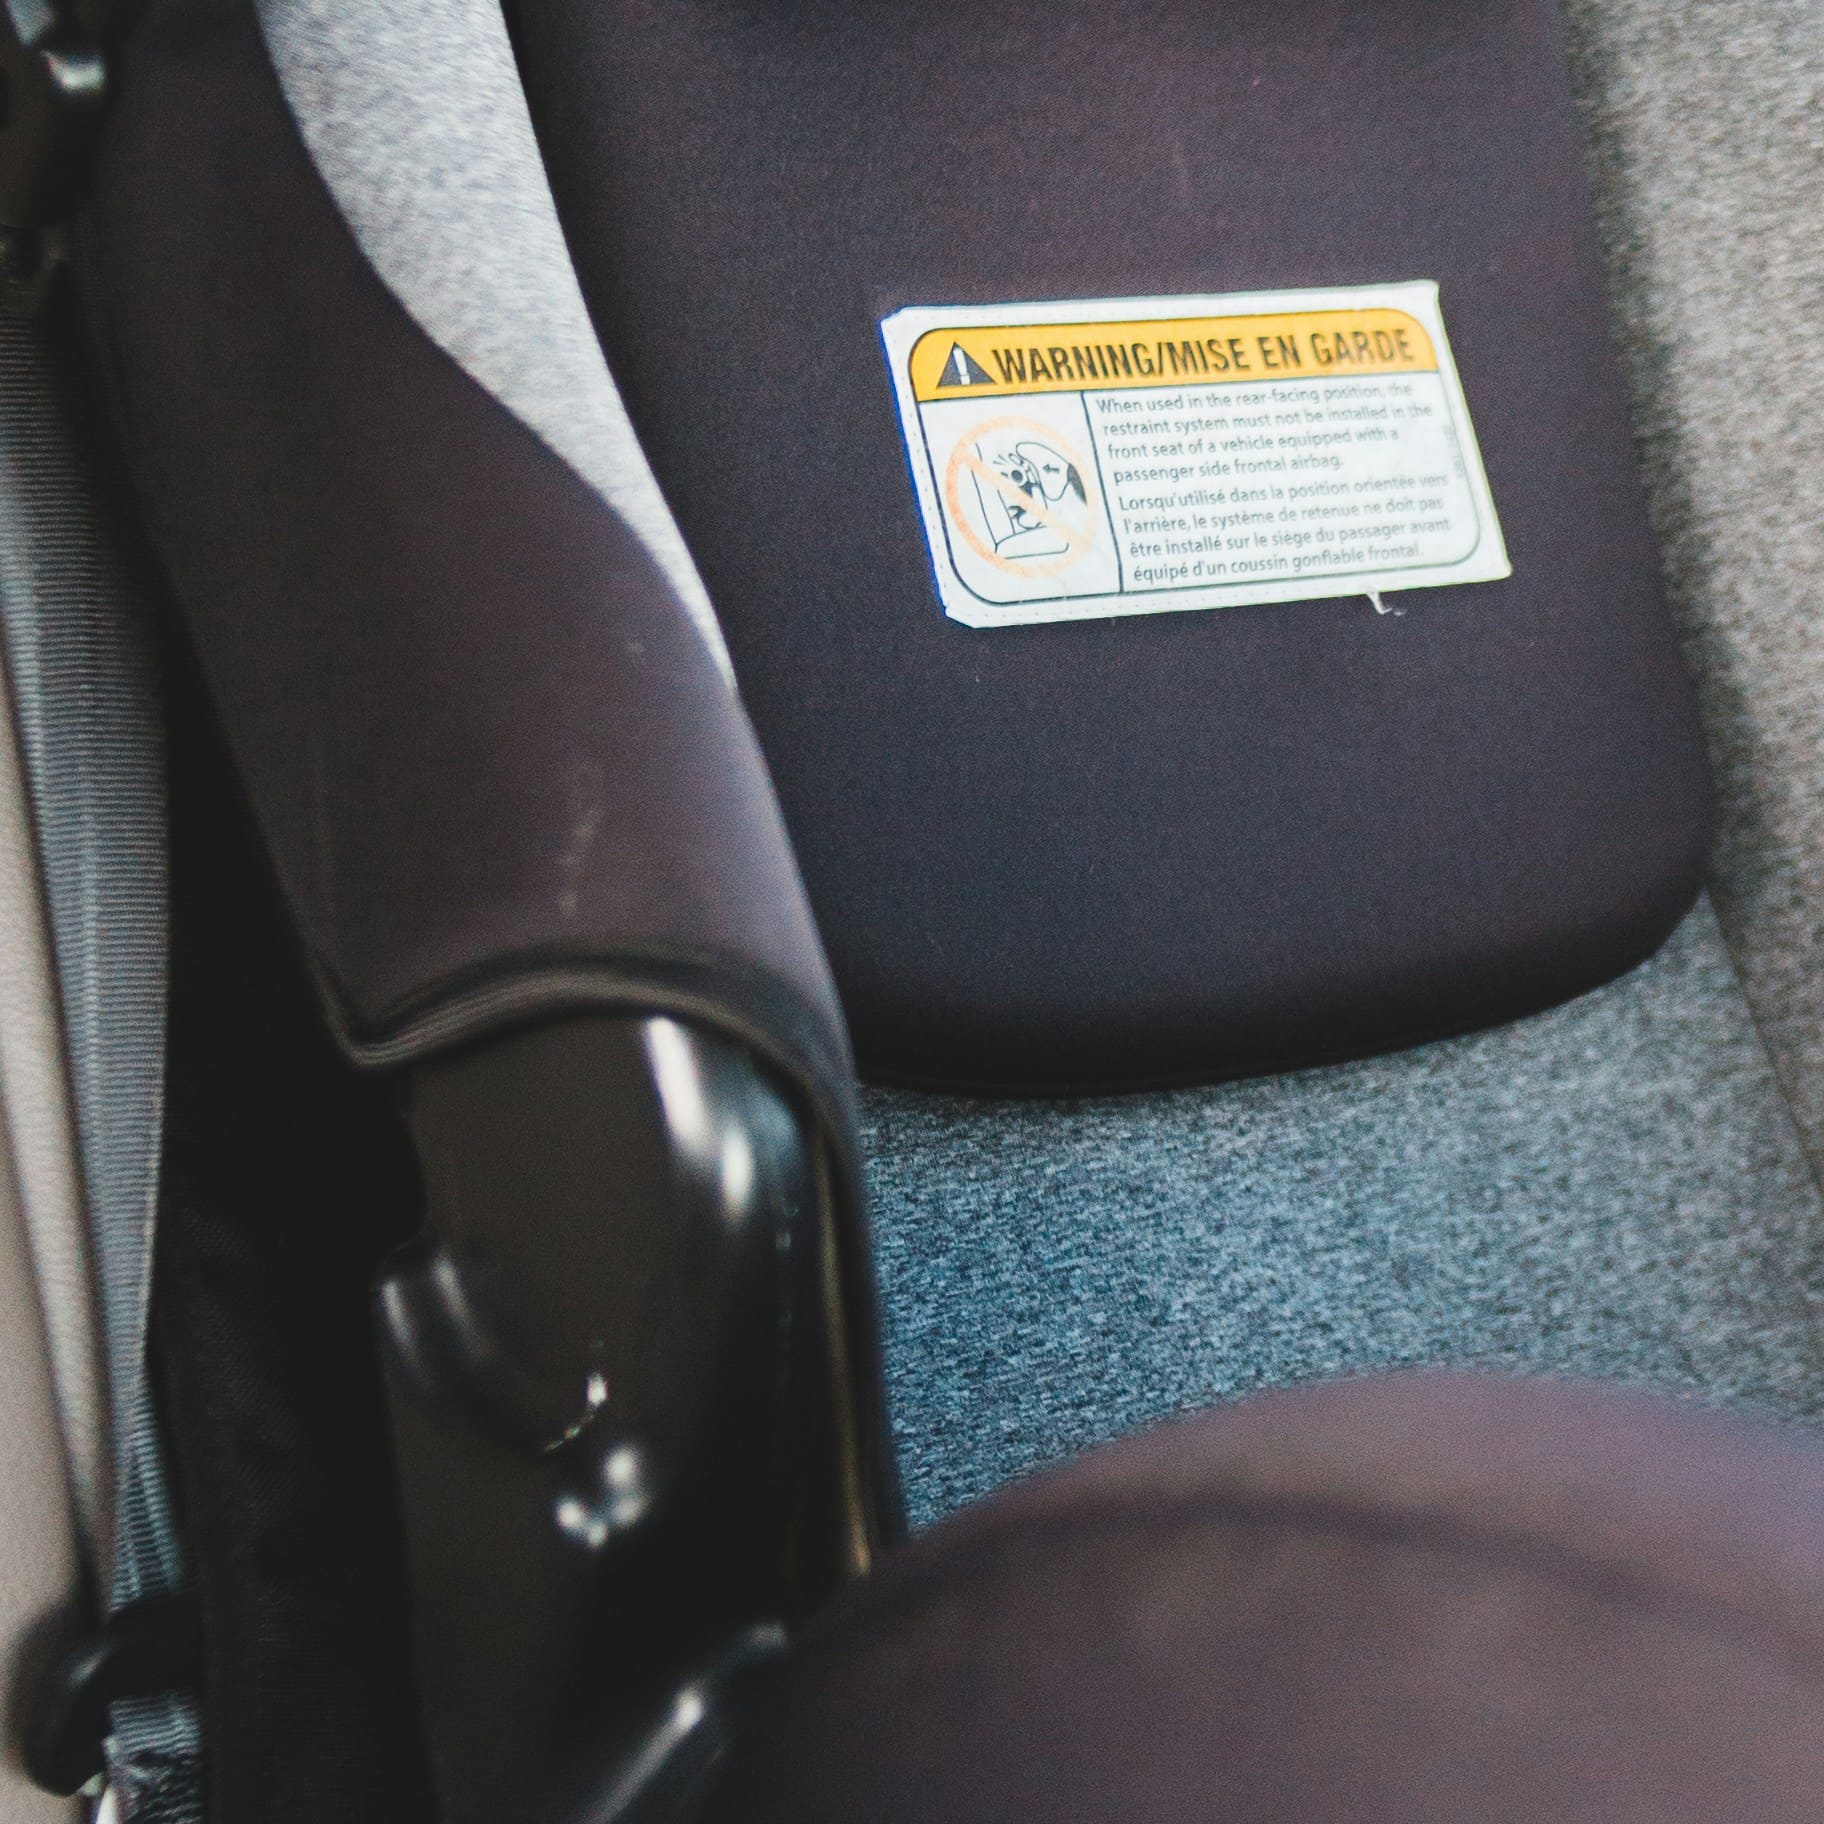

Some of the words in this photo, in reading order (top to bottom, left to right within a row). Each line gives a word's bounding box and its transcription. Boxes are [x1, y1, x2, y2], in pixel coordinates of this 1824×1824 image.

[992, 338, 1250, 384] WARNING/MISE
[1257, 334, 1301, 368] EN
[1310, 328, 1414, 365] GARDE
[1096, 398, 1143, 414] When
[1147, 395, 1184, 411] used
[1188, 393, 1202, 408] in
[1206, 392, 1232, 407] the
[1236, 388, 1320, 406] rear-facing
[1388, 382, 1413, 397] the
[1103, 420, 1171, 437] restraint
[1174, 418, 1229, 436] system
[1233, 415, 1271, 428] must
[1276, 412, 1301, 426] not
[1304, 410, 1323, 424] be
[1328, 406, 1388, 421] installed
[1392, 406, 1406, 419] in
[1408, 402, 1432, 417] the
[1108, 444, 1148, 460] front
[1153, 443, 1185, 457] seat
[1188, 438, 1203, 455] of
[1208, 442, 1217, 453] a
[1220, 435, 1275, 452] vehicle
[1278, 429, 1352, 450] equipped
[1355, 427, 1385, 442] with
[1389, 428, 1399, 440] a
[1113, 466, 1194, 486] passenger
[1199, 461, 1231, 476] side
[1234, 453, 1287, 473] frontal
[1291, 453, 1344, 472] airbag.
[1118, 489, 1227, 512] Lorsqu'utilisé
[1230, 488, 1267, 502] dans
[1271, 485, 1284, 499] la
[1288, 480, 1350, 501] position
[1354, 475, 1415, 493] orientée
[1419, 474, 1449, 488] vers
[1193, 514, 1207, 529] le
[1211, 510, 1275, 531] système
[1278, 507, 1297, 522] de
[1301, 503, 1359, 520] retenue
[1363, 501, 1383, 515] ne
[1386, 498, 1415, 513] doit
[1419, 496, 1444, 513] pas
[1130, 542, 1162, 558] être
[1165, 536, 1222, 555] installé
[1226, 537, 1250, 550] sur
[1254, 532, 1269, 547] le
[1272, 529, 1312, 548] siège
[1316, 527, 1336, 543] du
[1339, 524, 1408, 545] passager
[1410, 519, 1451, 534] avant
[1133, 566, 1190, 584] équipé
[1193, 560, 1227, 577] d'un
[1231, 556, 1288, 574] coussin
[1292, 548, 1365, 572] gonflable
